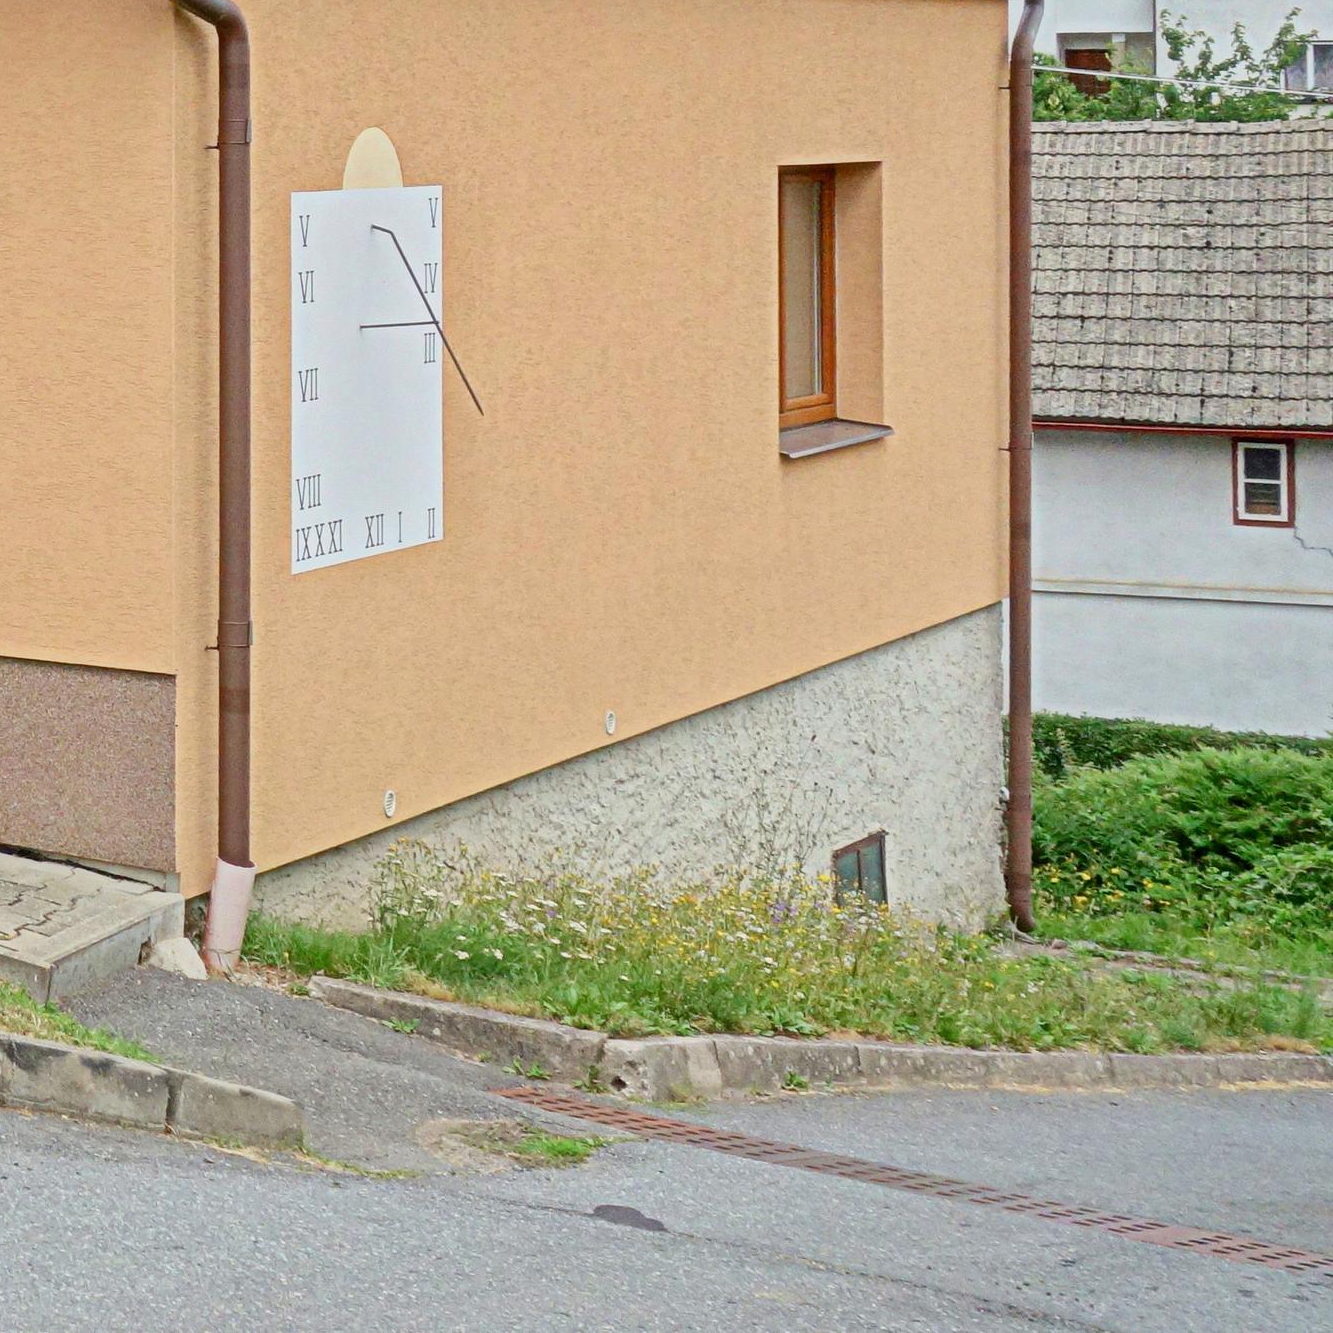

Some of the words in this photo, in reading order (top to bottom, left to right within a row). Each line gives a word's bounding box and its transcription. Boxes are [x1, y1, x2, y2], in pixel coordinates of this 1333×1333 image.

[428, 197, 439, 228] V
[299, 215, 310, 247] V
[298, 269, 315, 303] VI
[424, 262, 438, 294] IV
[423, 332, 436, 364] III
[298, 367, 319, 403] VII
[296, 473, 322, 511] VIII
[364, 513, 385, 549] XII
